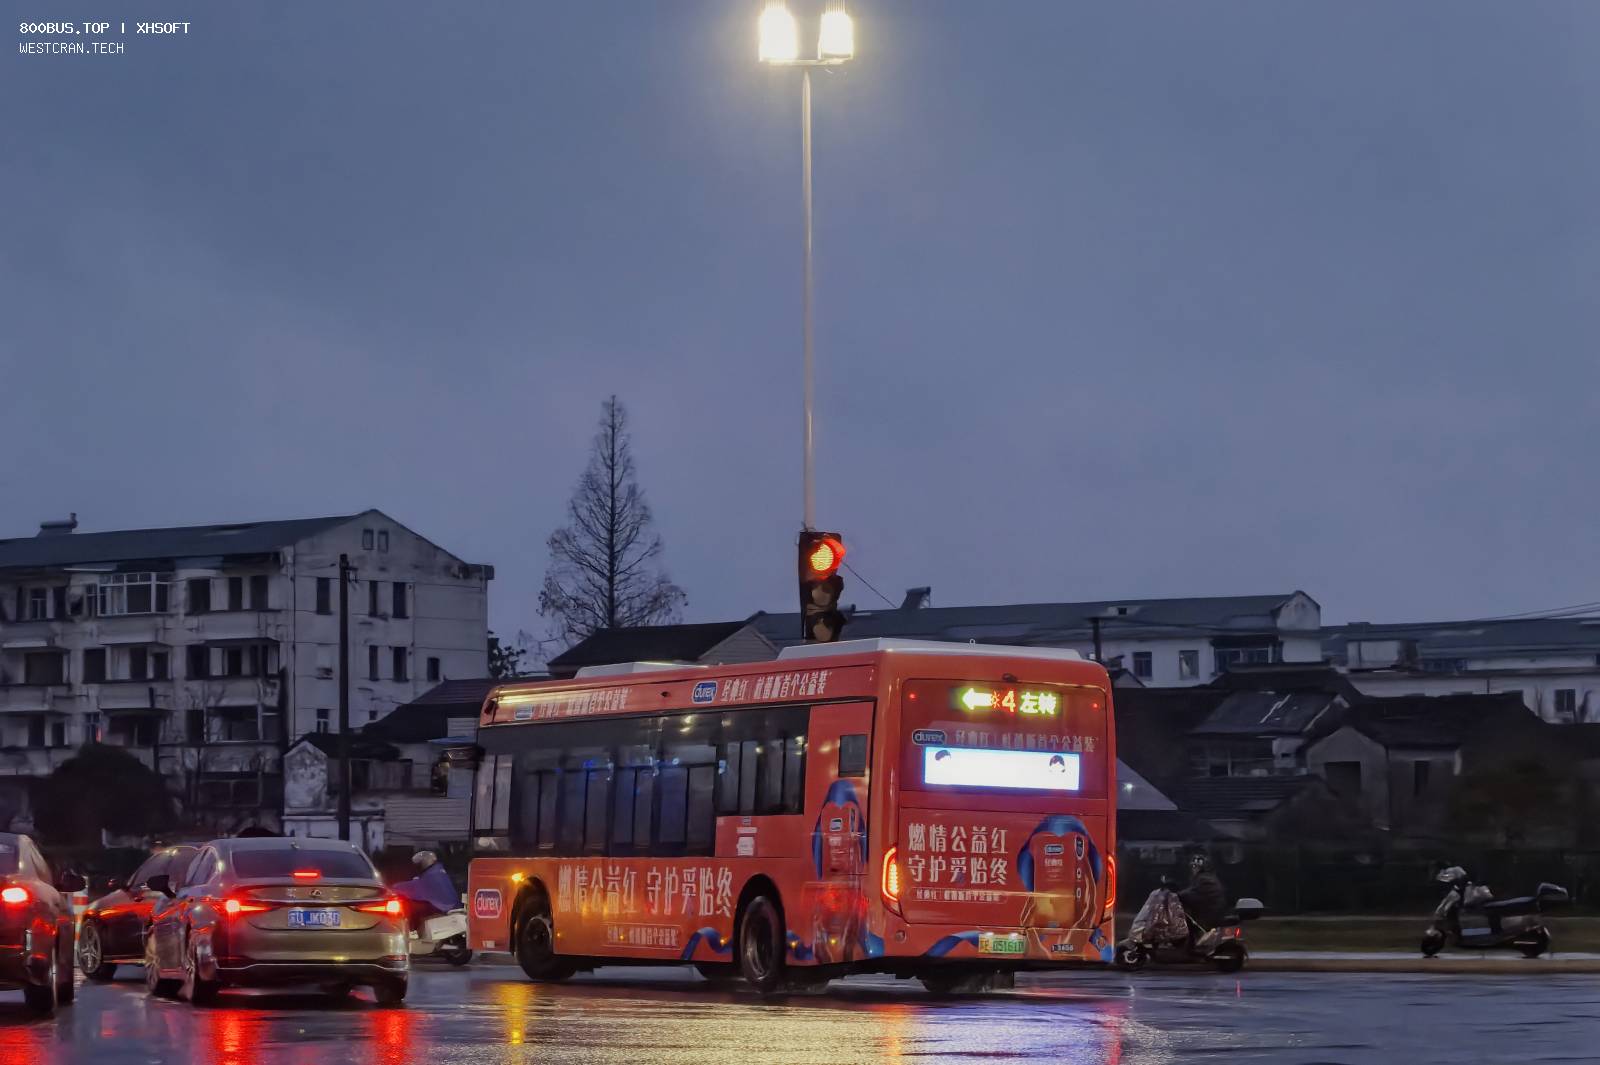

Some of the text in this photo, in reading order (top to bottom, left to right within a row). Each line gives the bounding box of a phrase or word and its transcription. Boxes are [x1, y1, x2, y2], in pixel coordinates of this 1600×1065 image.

[1001, 690, 1057, 715] 4 左转
[908, 822, 1009, 854] 燃情公益红
[907, 854, 1008, 886] 守护爱始终
[476, 892, 499, 911] durex
[557, 864, 733, 918] 燃情公益红 守护爱始终
